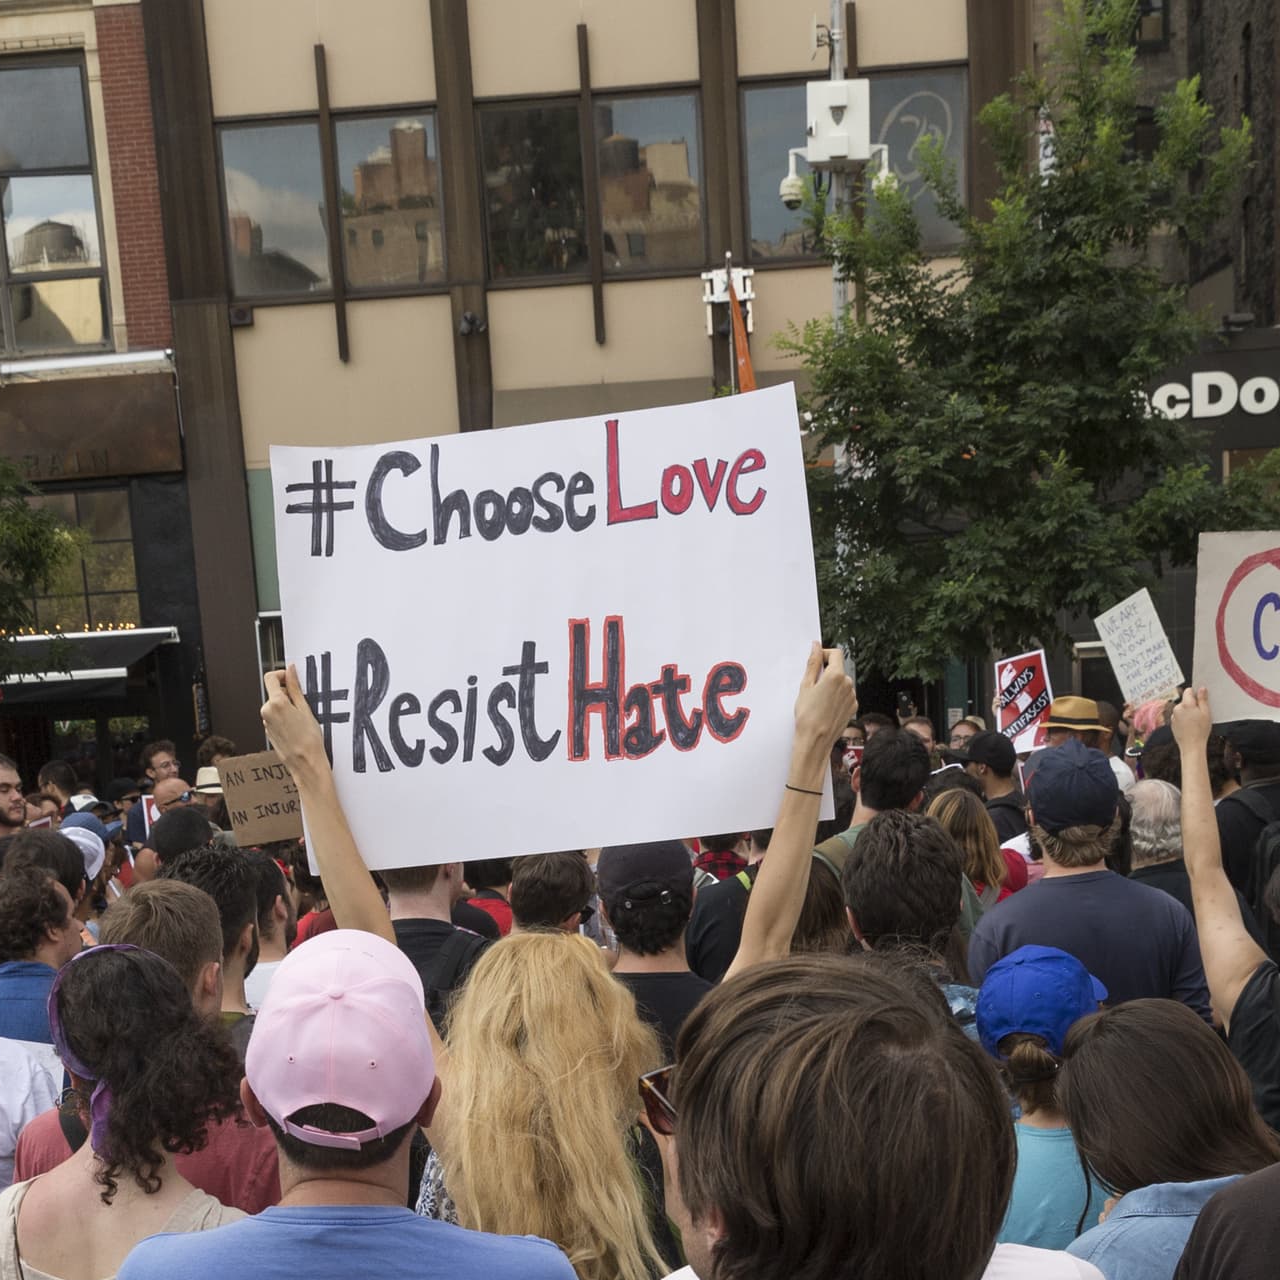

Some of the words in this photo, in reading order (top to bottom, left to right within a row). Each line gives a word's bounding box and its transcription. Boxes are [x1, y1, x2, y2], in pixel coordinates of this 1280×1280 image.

[225, 769, 245, 787] AN
[232, 810, 249, 825] AN
[254, 799, 300, 819] INJUR
